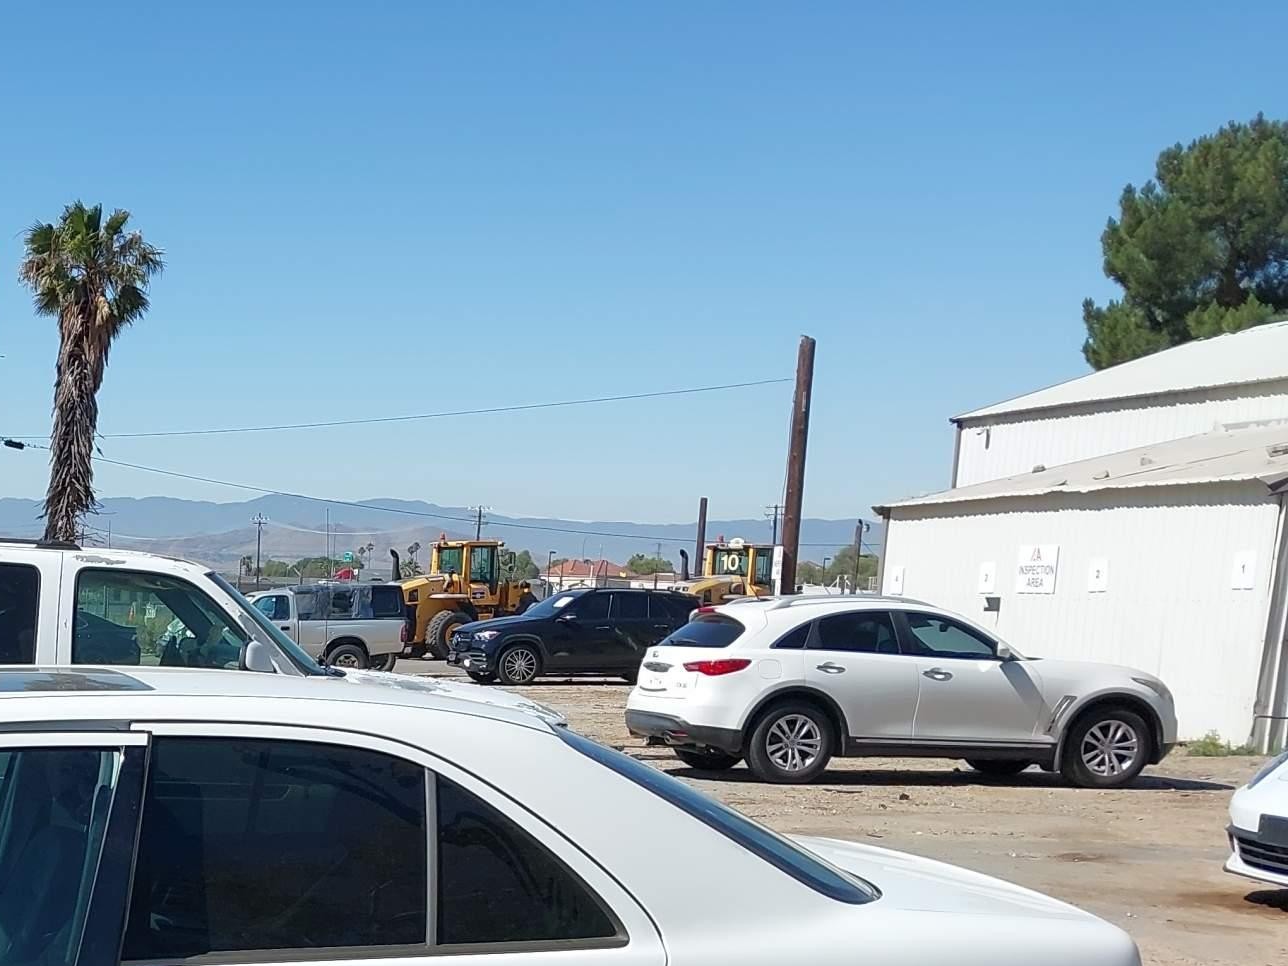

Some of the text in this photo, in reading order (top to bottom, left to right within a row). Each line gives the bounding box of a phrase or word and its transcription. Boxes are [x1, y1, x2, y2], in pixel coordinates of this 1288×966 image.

[720, 554, 739, 571] 10
[1018, 565, 1054, 575] INSPECTION
[1026, 577, 1043, 588] AREA
